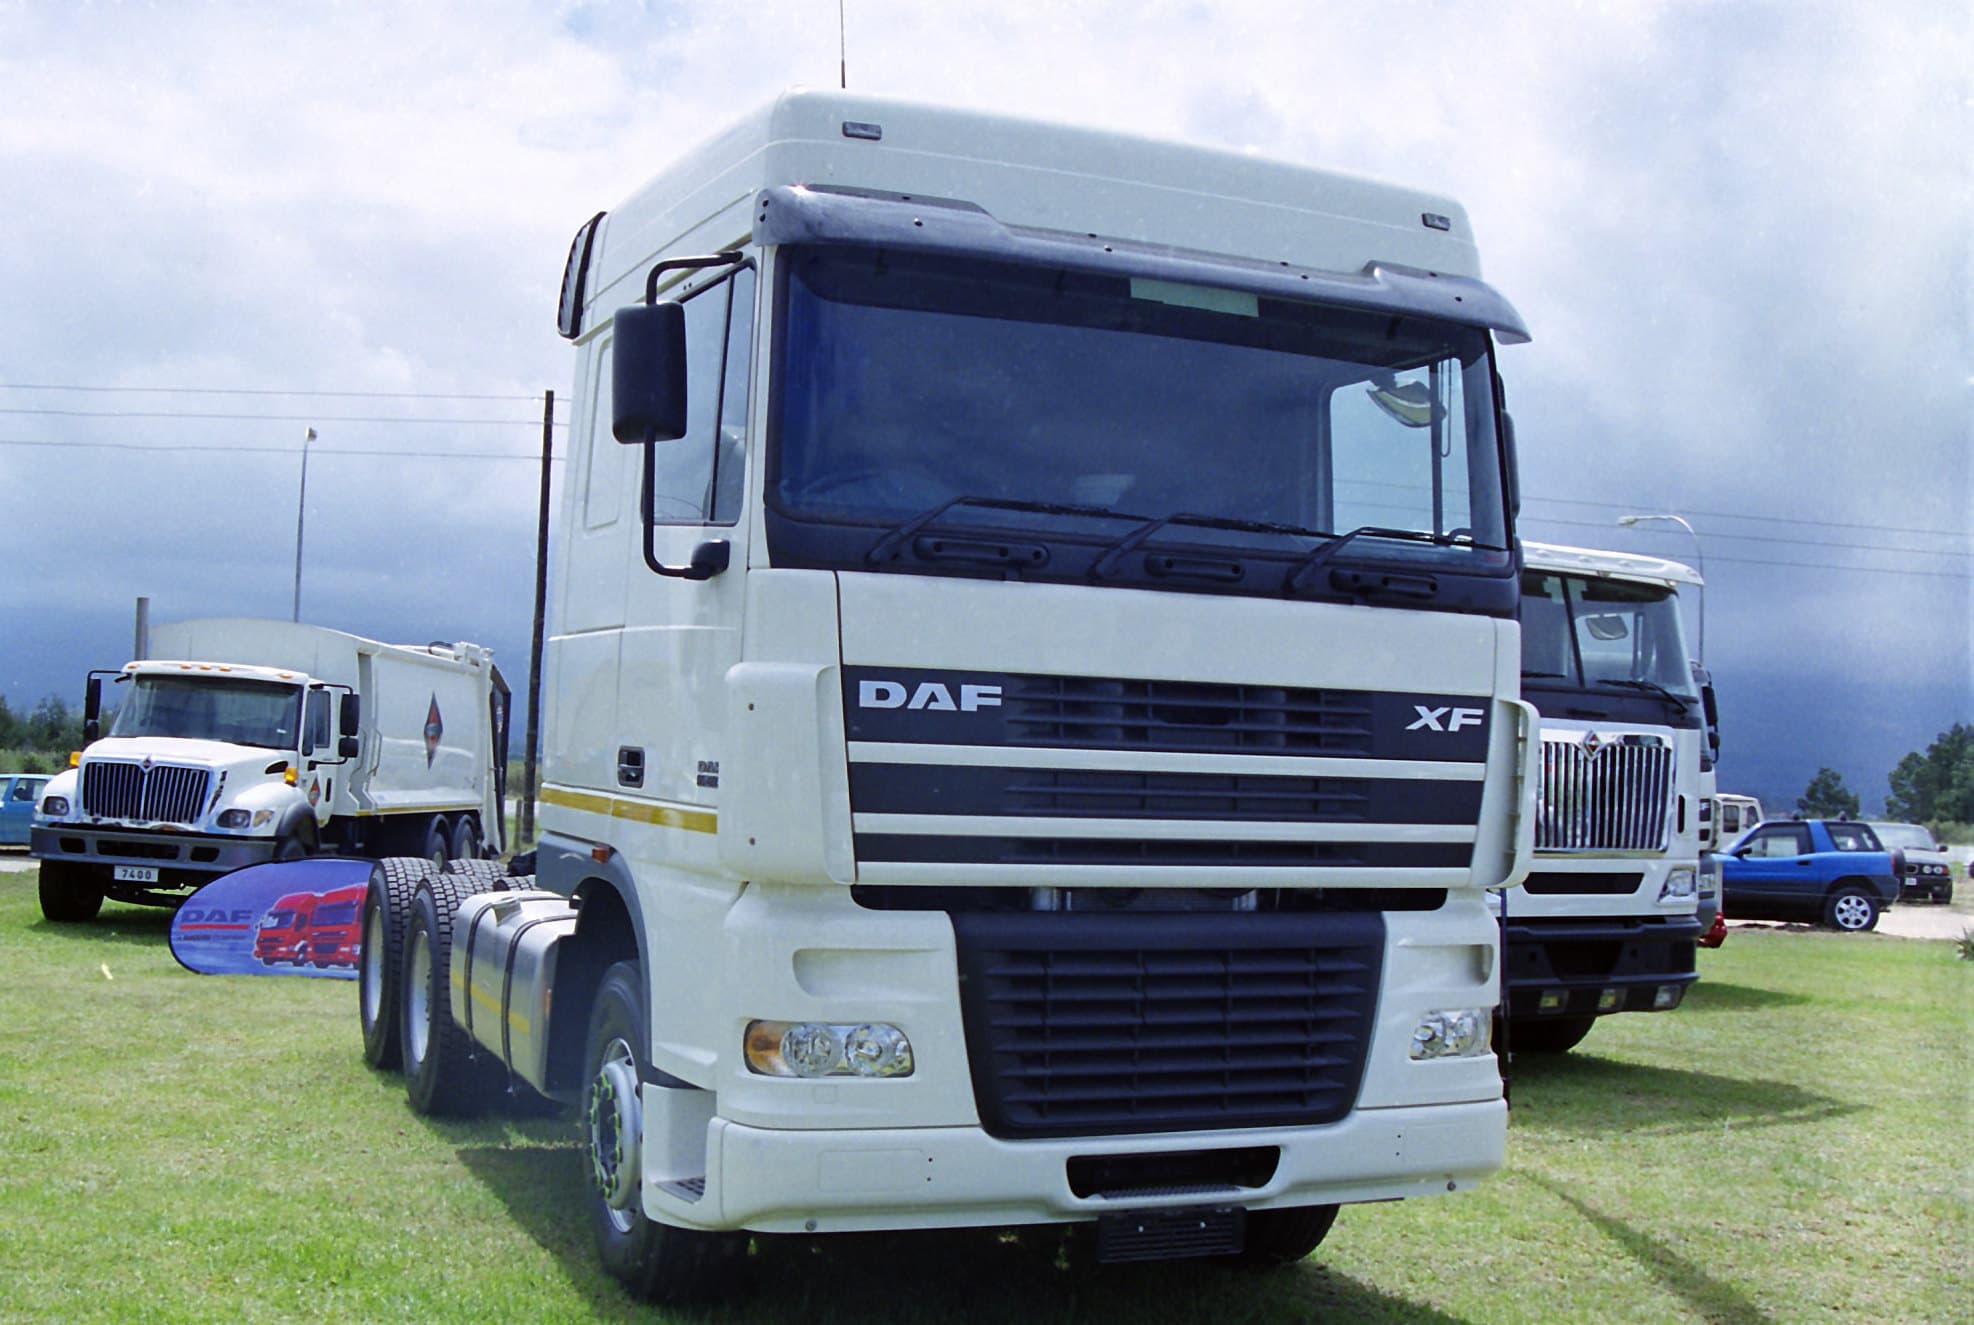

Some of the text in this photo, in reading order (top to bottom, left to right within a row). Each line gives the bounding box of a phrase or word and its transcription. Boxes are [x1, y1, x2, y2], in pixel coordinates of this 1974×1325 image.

[859, 680, 1002, 712] DAF
[1405, 705, 1484, 732] XF
[181, 909, 253, 922] DAF
